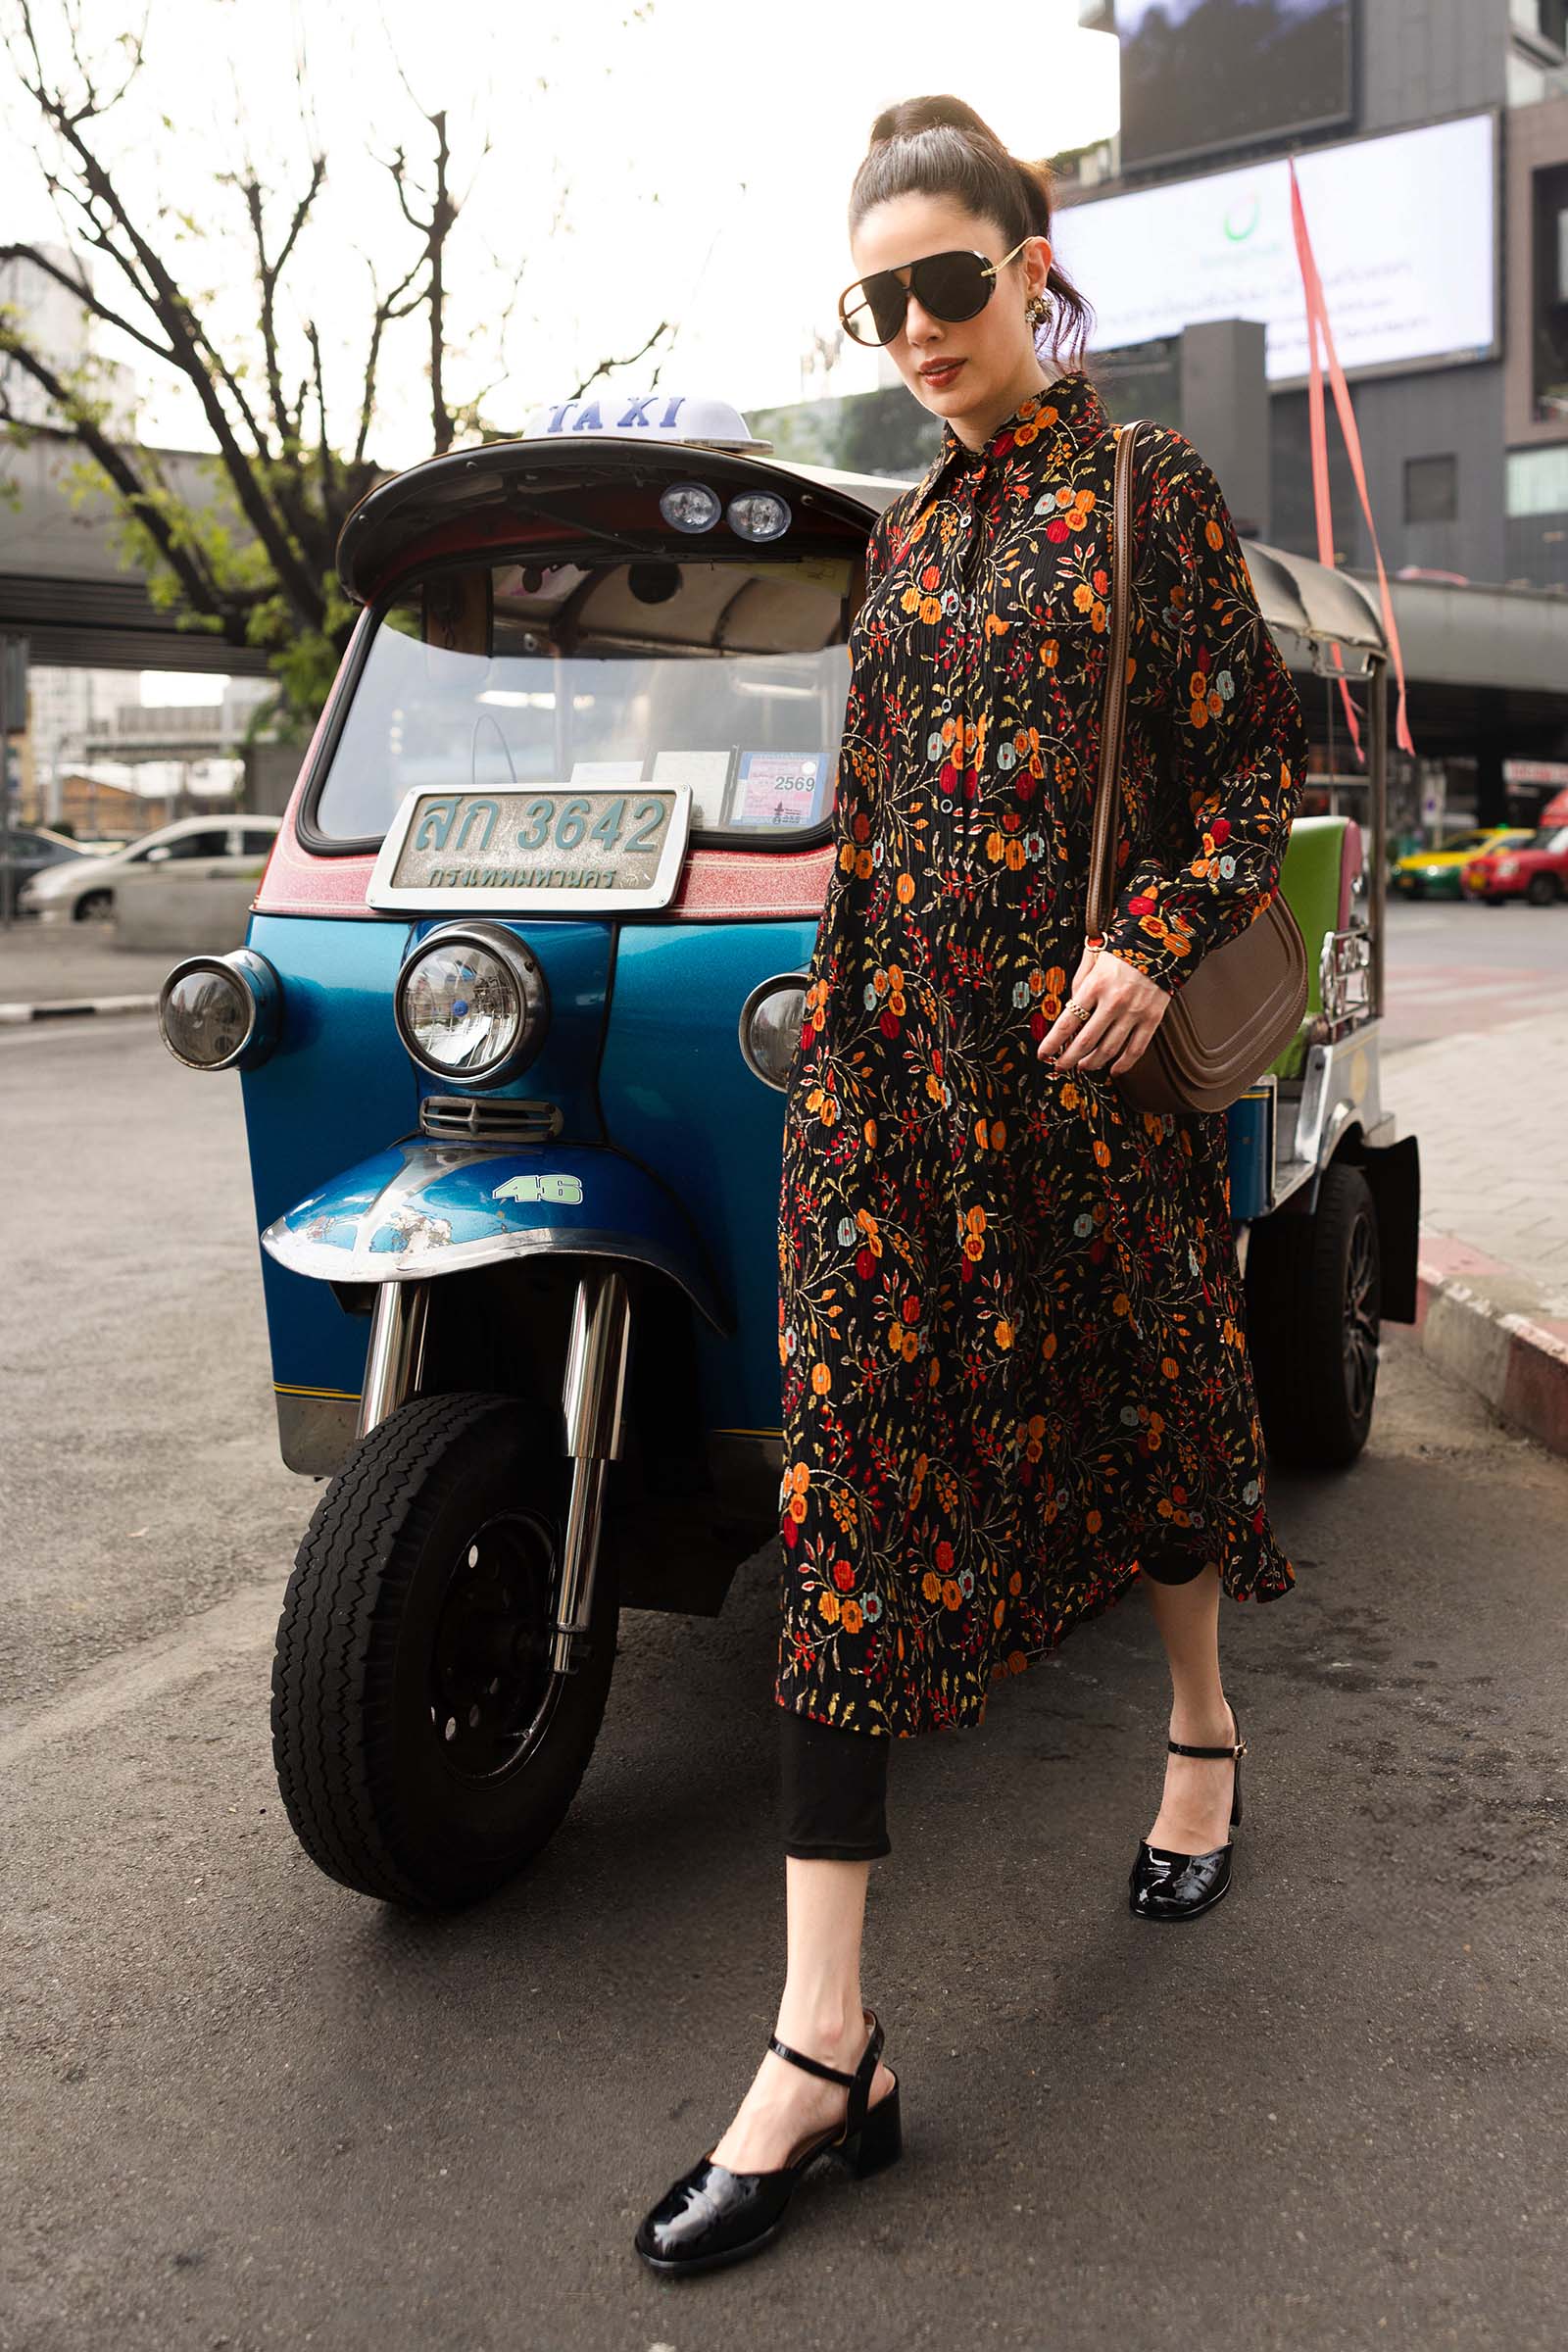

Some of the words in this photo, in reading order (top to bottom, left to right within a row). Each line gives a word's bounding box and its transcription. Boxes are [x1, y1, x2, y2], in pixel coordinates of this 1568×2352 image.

[547, 396, 685, 432] TAXI
[774, 776, 815, 792] 2569
[415, 797, 500, 851] สก
[516, 799, 664, 852] 3642
[427, 867, 617, 888] กรงเทพมหานคร
[493, 1175, 583, 1204] 46
